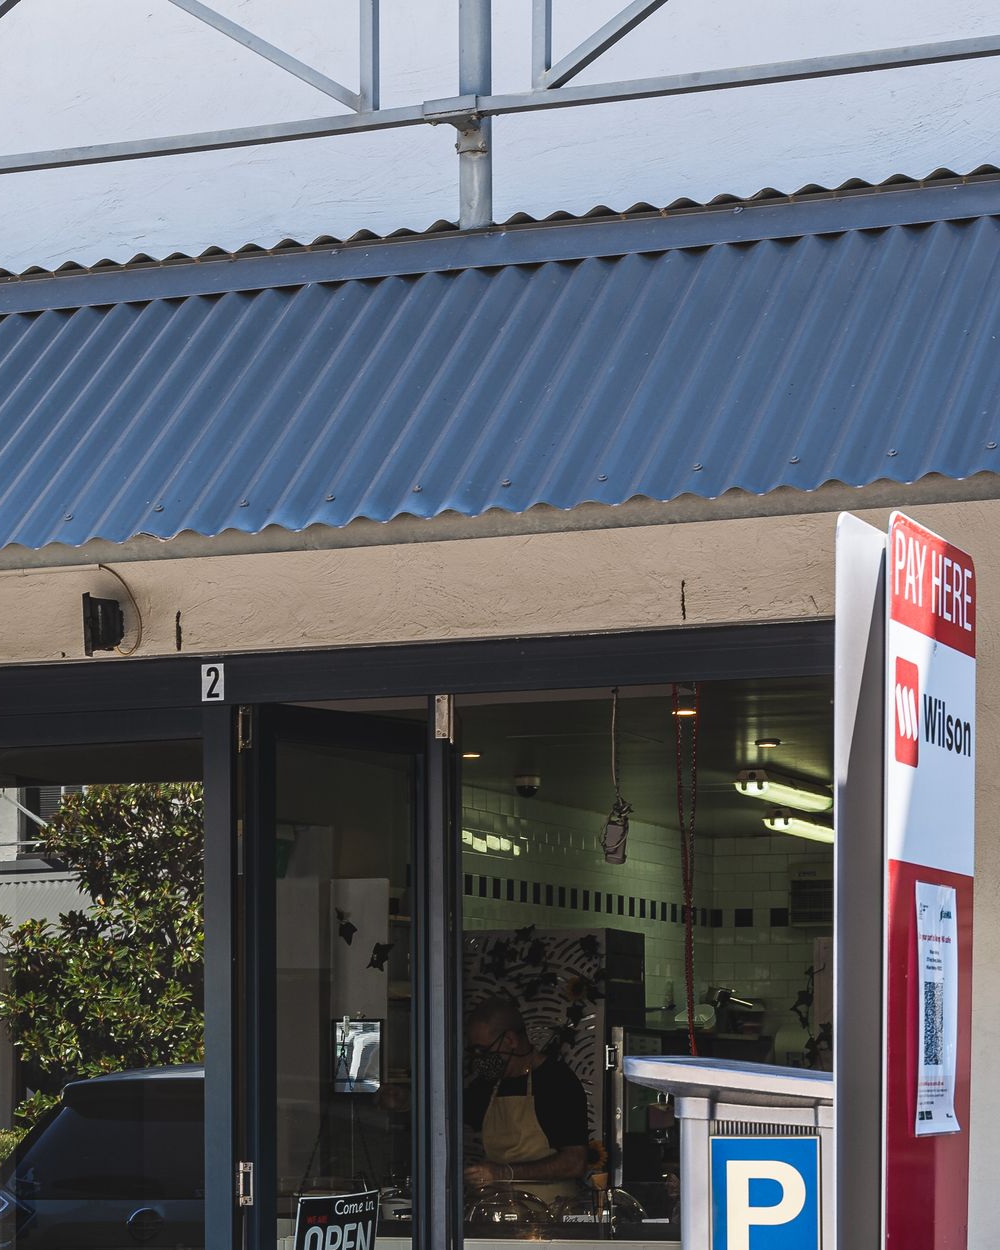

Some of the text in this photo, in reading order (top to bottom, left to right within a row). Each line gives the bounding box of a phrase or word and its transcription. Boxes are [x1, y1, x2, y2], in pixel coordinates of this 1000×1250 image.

[894, 528, 972, 632] PAY HERE
[206, 666, 220, 699] 2
[923, 694, 971, 757] Wilson
[335, 1197, 374, 1215] Come in
